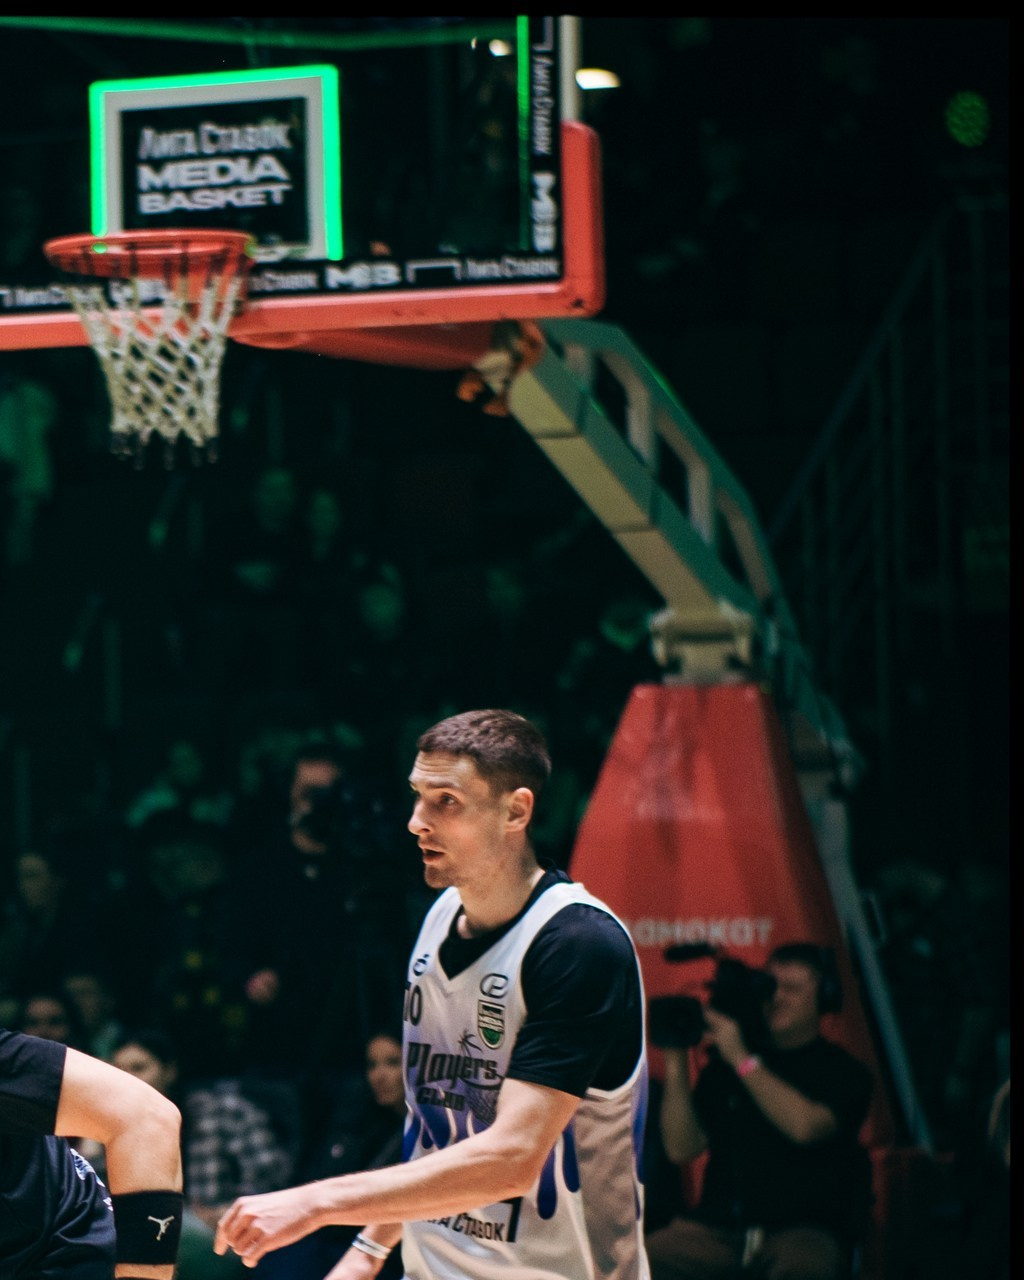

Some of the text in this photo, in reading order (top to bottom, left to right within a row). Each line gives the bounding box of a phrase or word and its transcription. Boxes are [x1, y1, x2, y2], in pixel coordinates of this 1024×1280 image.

[138, 154, 290, 190] MEDIA
[138, 183, 292, 214] BASKET
[407, 1041, 499, 1090] Players
